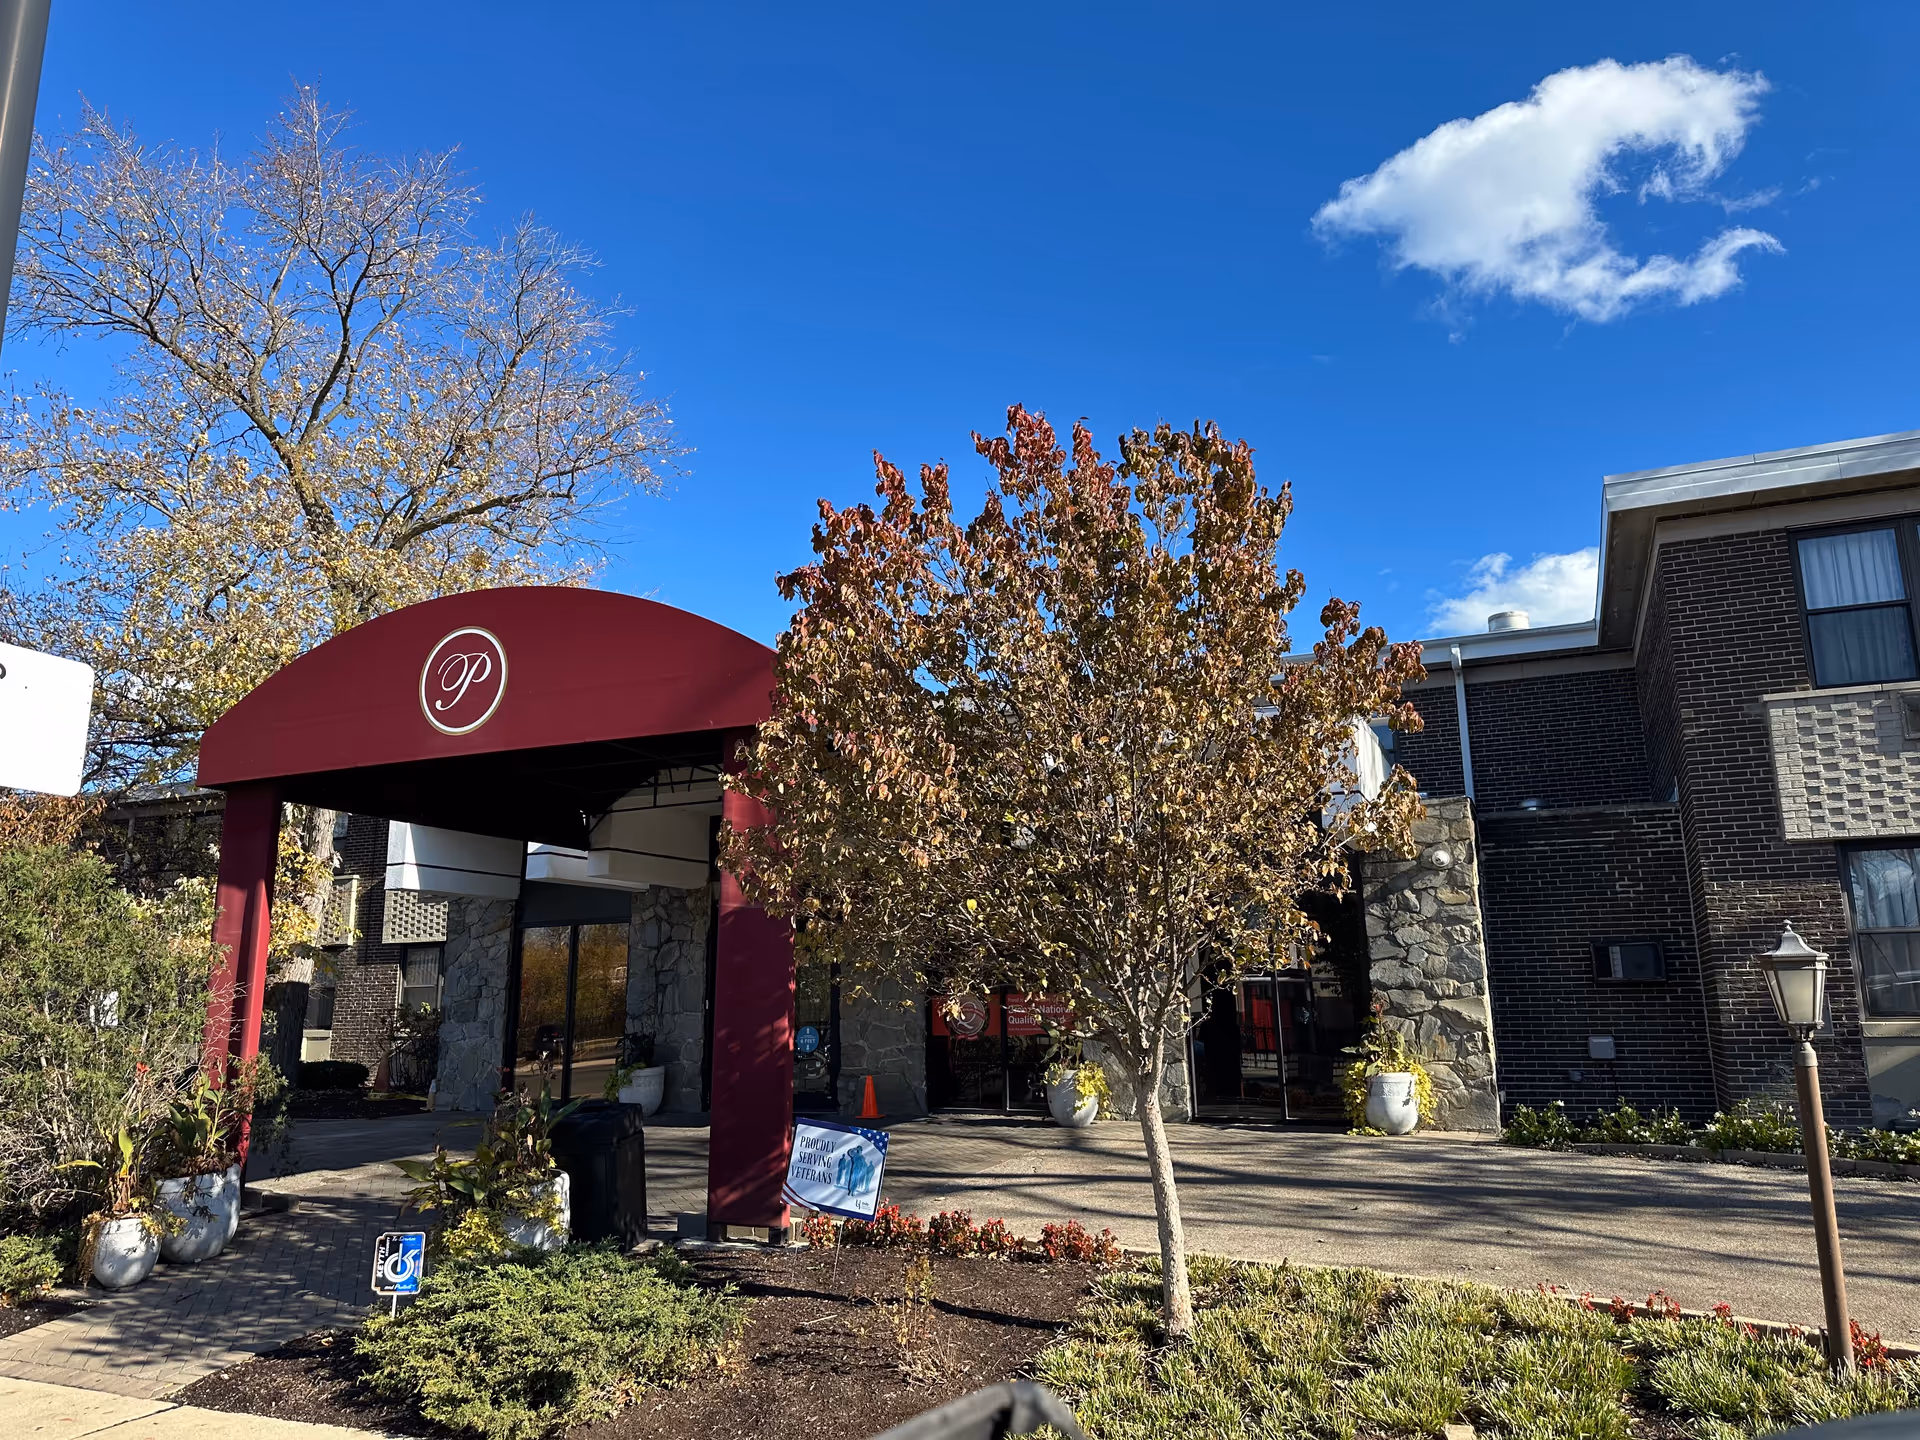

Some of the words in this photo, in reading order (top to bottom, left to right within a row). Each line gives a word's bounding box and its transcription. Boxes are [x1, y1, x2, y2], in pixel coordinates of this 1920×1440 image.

[435, 651, 492, 711] P
[1008, 1016, 1036, 1026] Quality
[799, 1136, 837, 1154] PROUDLY
[798, 1151, 833, 1169] SERVING
[791, 1165, 833, 1185] VETERANS
[377, 1246, 386, 1278] KEYTH
